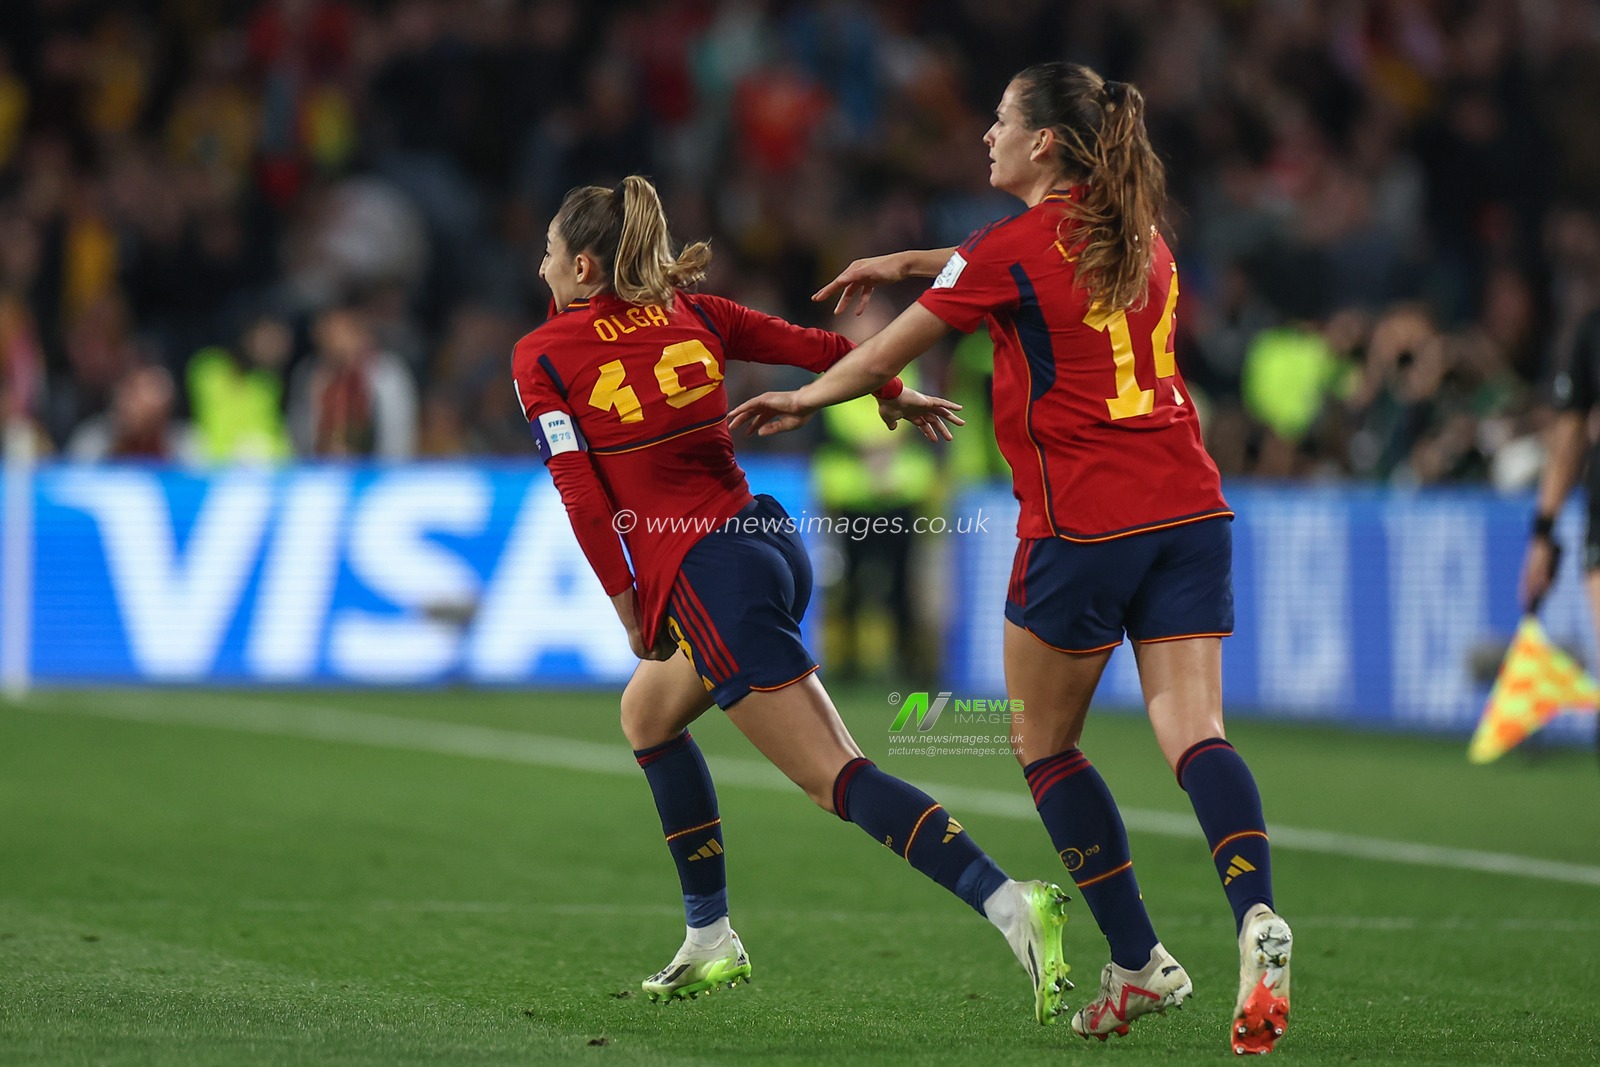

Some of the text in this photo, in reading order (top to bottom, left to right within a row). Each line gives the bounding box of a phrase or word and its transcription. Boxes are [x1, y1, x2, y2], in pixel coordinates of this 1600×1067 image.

[593, 304, 669, 341] OLGA
[548, 419, 566, 428] FIFA
[48, 468, 645, 682] VISA
